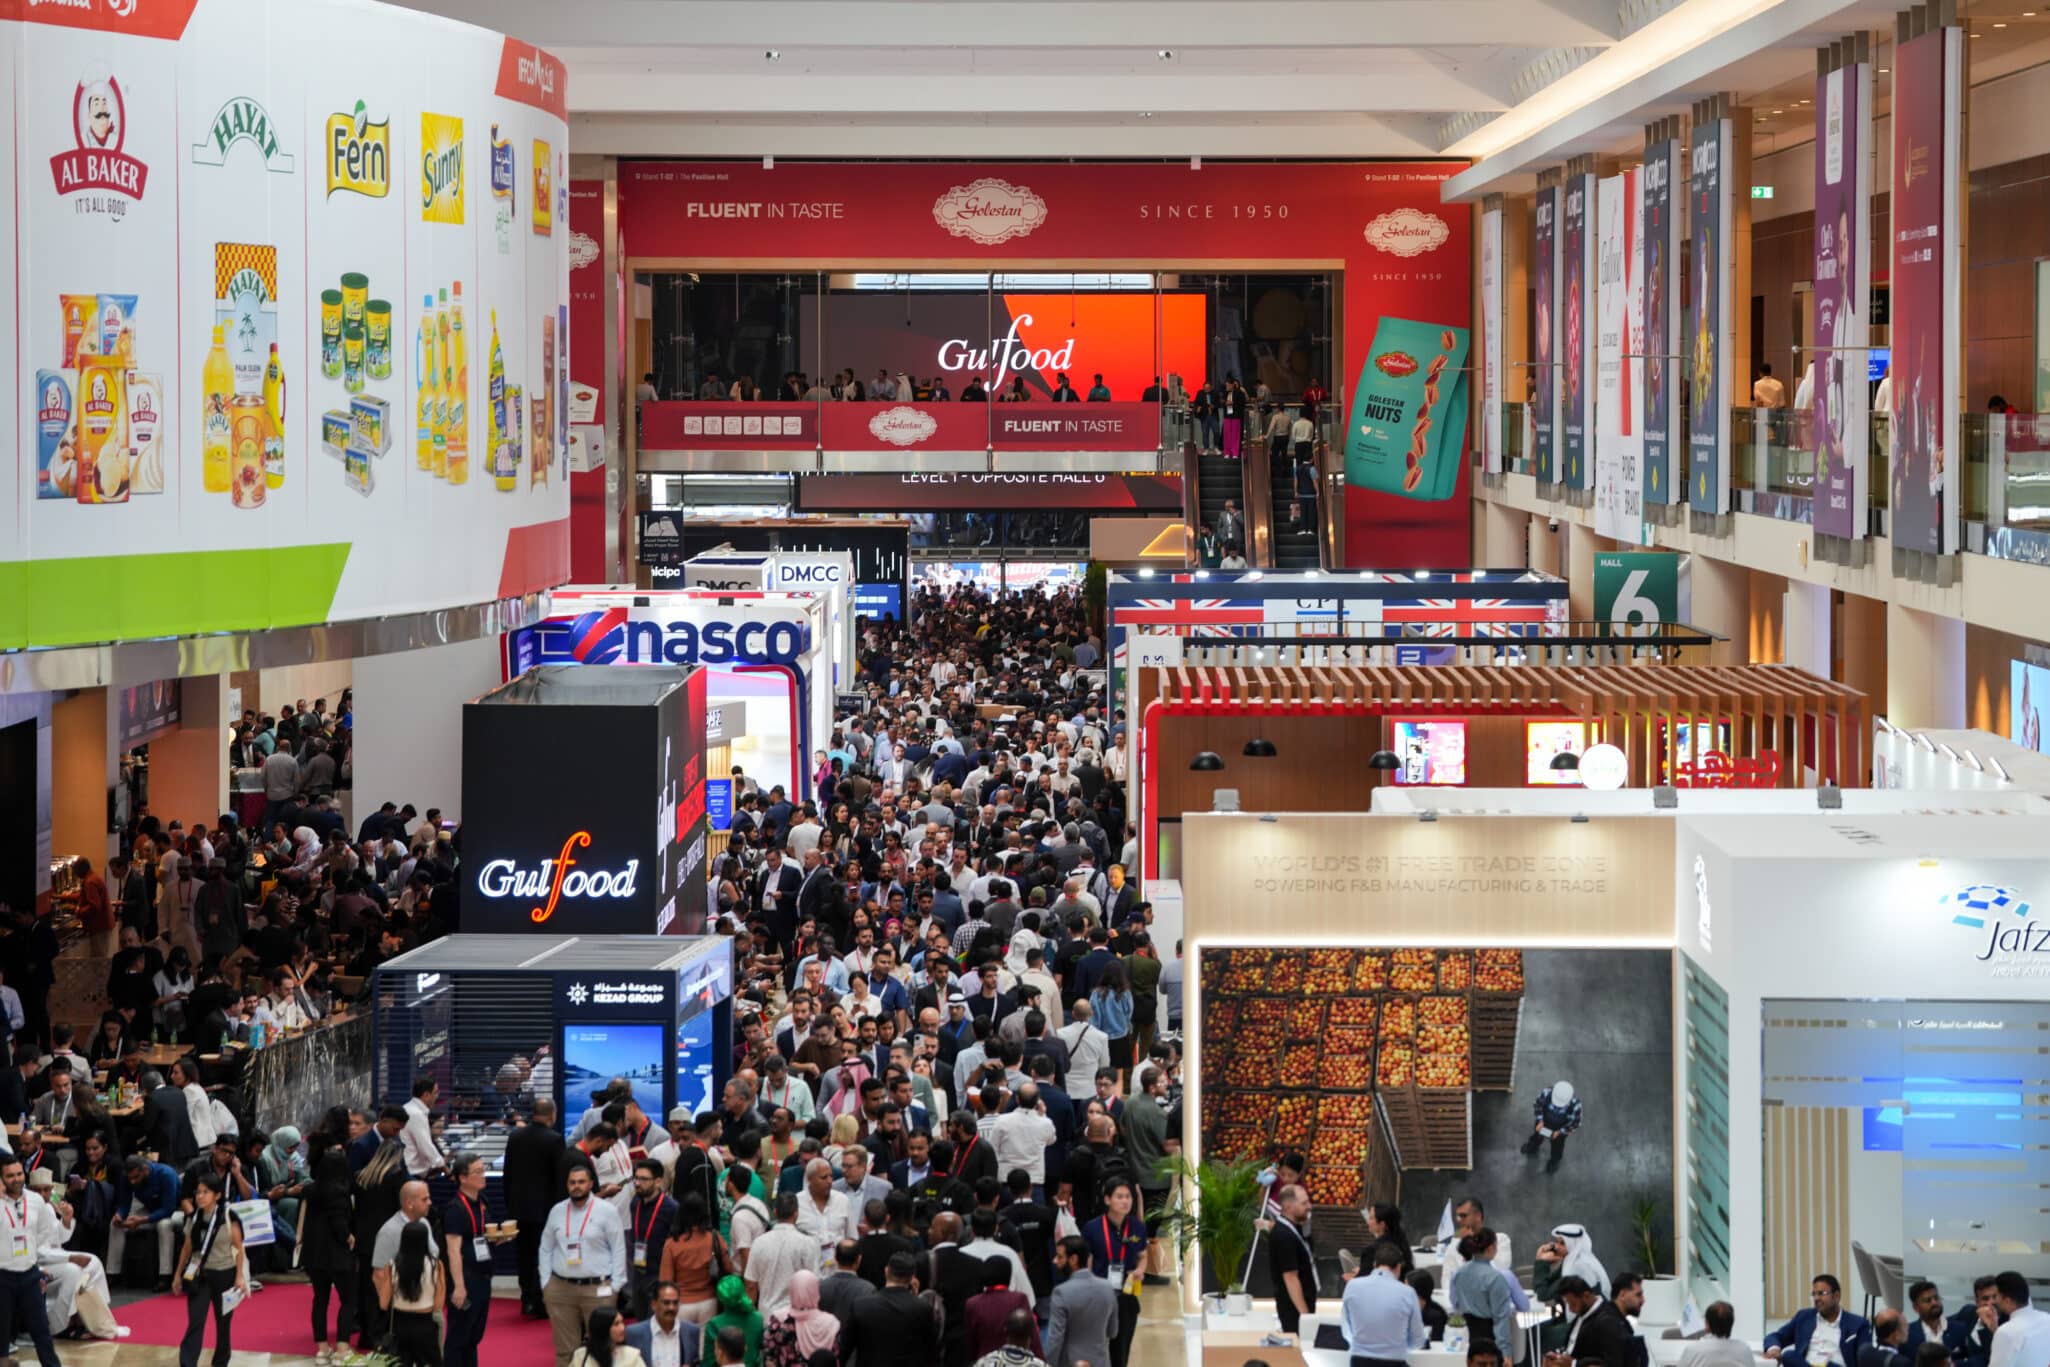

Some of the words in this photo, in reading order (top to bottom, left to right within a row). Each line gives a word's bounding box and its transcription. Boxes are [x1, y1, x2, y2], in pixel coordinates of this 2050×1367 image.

[518, 56, 535, 86] IFFCO
[213, 101, 279, 160] HAYAT
[334, 128, 386, 183] Fern
[62, 160, 84, 188] AL
[87, 154, 139, 193] BAKER
[423, 141, 463, 208] Sunny
[75, 197, 90, 214] IT'S
[92, 198, 105, 213] ALL
[107, 198, 127, 217] GOOD
[687, 203, 762, 218] FLUENT
[767, 203, 784, 218] IN
[789, 203, 844, 218] TASTE
[957, 197, 1022, 219] Golestan
[1140, 205, 1215, 219] SINCE
[1232, 205, 1290, 219] 1950
[1382, 221, 1430, 238] Golestan
[1372, 273, 1407, 281] SINCE
[1415, 273, 1442, 281] 1950
[230, 270, 268, 305] HAYAT
[937, 314, 1076, 392] Gulfood
[1368, 394, 1405, 408] GOLESTAN
[1364, 403, 1403, 424] NUTS
[1004, 420, 1061, 433] FLUENT
[1065, 420, 1078, 433] IN
[1081, 420, 1123, 433] TASTE
[1600, 559, 1623, 567] HALL
[781, 566, 840, 582] DMCC
[1611, 570, 1660, 638] 6
[627, 620, 802, 664] nasco
[1254, 855, 1361, 872] WORLD'S
[1399, 856, 1454, 872] FREE
[1458, 856, 1536, 872] TRADE
[1543, 856, 1608, 872] ZONE
[478, 831, 640, 923] Gulfood
[1254, 879, 1345, 893] POWERING
[1351, 879, 1381, 893] F&B
[1385, 879, 1531, 893] MANUFACTURING
[1535, 879, 1546, 893] &
[1549, 879, 1608, 893] TRADE
[593, 993, 627, 1003] KEZAD
[627, 993, 664, 1003] GROUP
